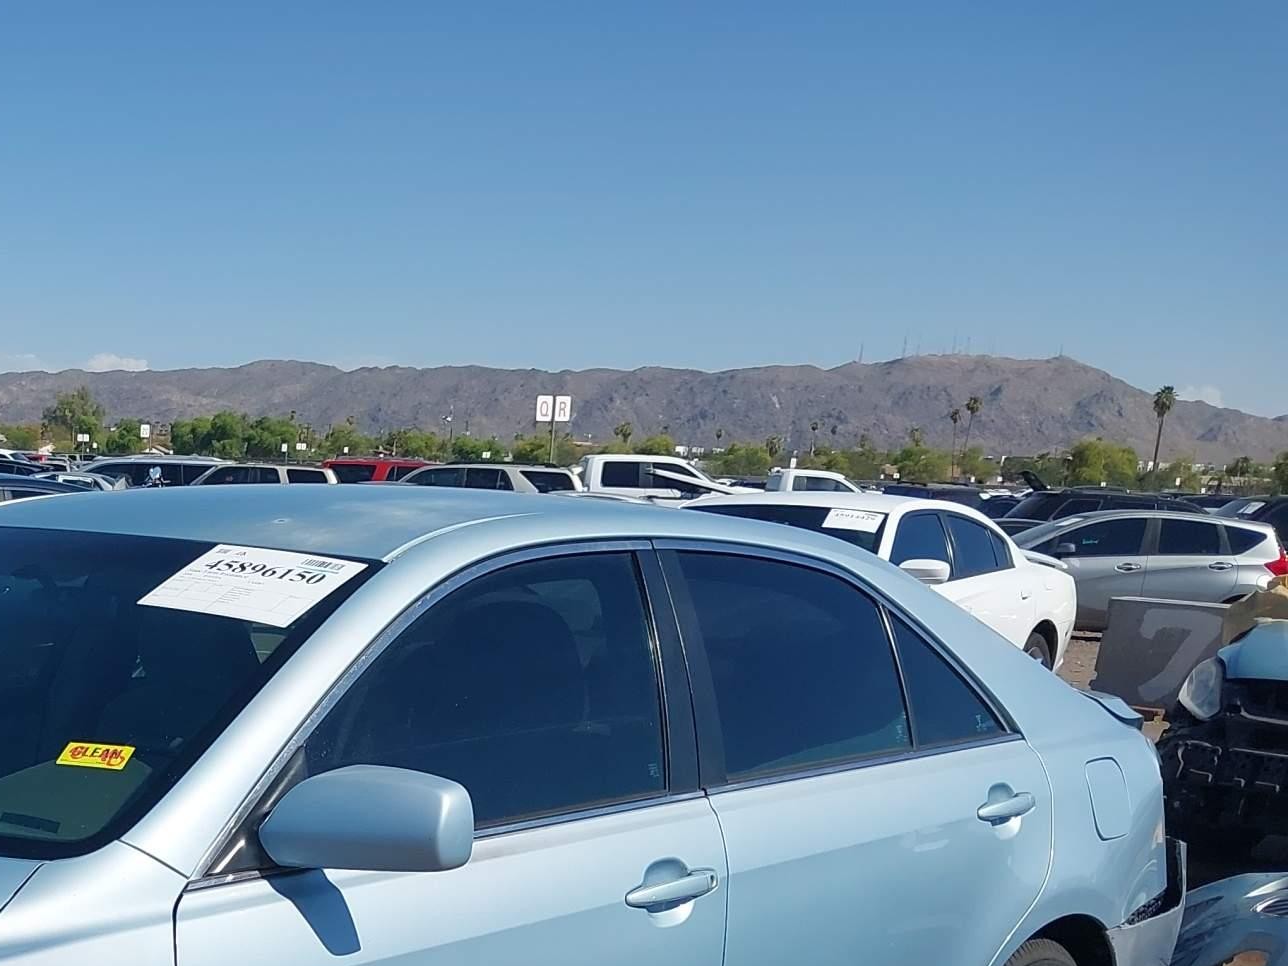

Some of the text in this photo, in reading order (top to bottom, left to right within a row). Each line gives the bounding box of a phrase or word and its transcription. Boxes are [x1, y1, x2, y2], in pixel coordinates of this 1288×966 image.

[540, 400, 567, 417] Q R
[205, 558, 327, 585] 45896150
